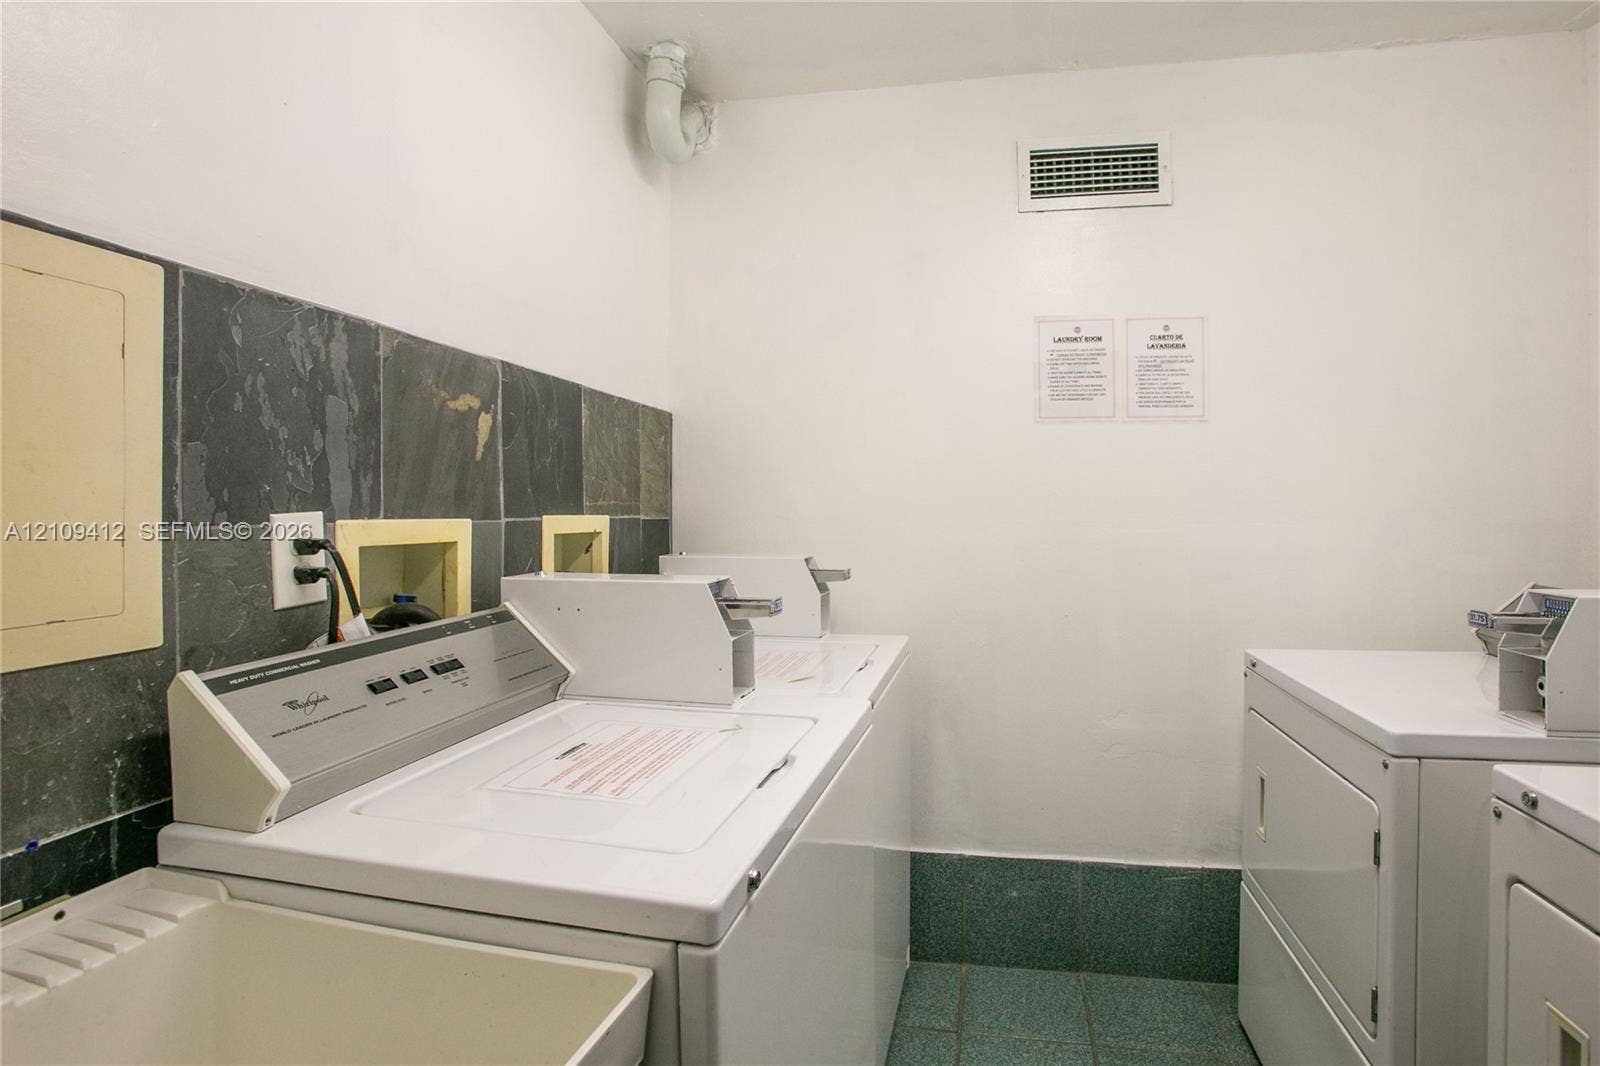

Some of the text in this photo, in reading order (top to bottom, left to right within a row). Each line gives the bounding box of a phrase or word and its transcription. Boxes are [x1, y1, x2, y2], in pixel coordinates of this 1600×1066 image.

[229, 658, 321, 685] HEAVY DUTY COMMERCIAL WASHER
[284, 692, 330, 715] Whirlpool
[271, 728, 293, 738] WORLD
